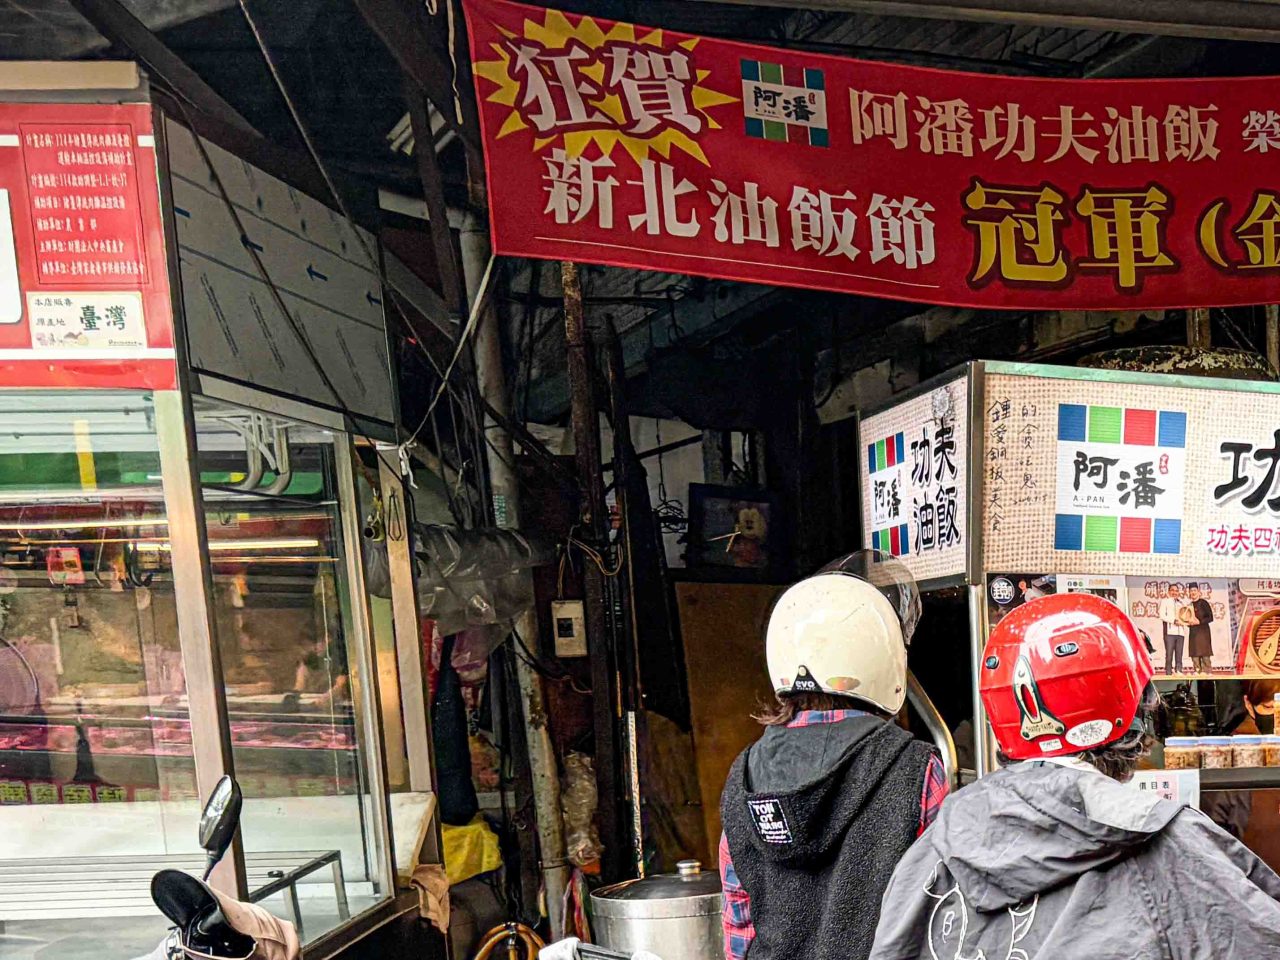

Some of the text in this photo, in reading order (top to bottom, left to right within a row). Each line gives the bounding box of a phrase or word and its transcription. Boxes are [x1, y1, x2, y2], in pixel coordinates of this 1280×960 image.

[508, 39, 703, 134] 狂賀
[753, 86, 816, 121] 阿潘
[849, 87, 1220, 164] 阿潘功夫油飯
[542, 148, 936, 270] 新北油飯節
[79, 305, 127, 331] 臺灣
[910, 417, 958, 486] 功夫
[1073, 451, 1166, 509] 阿潘
[874, 478, 902, 520] 阿潘
[912, 484, 960, 556] 油飯
[795, 680, 815, 688] evo
[1139, 781, 1169, 790] 價目表
